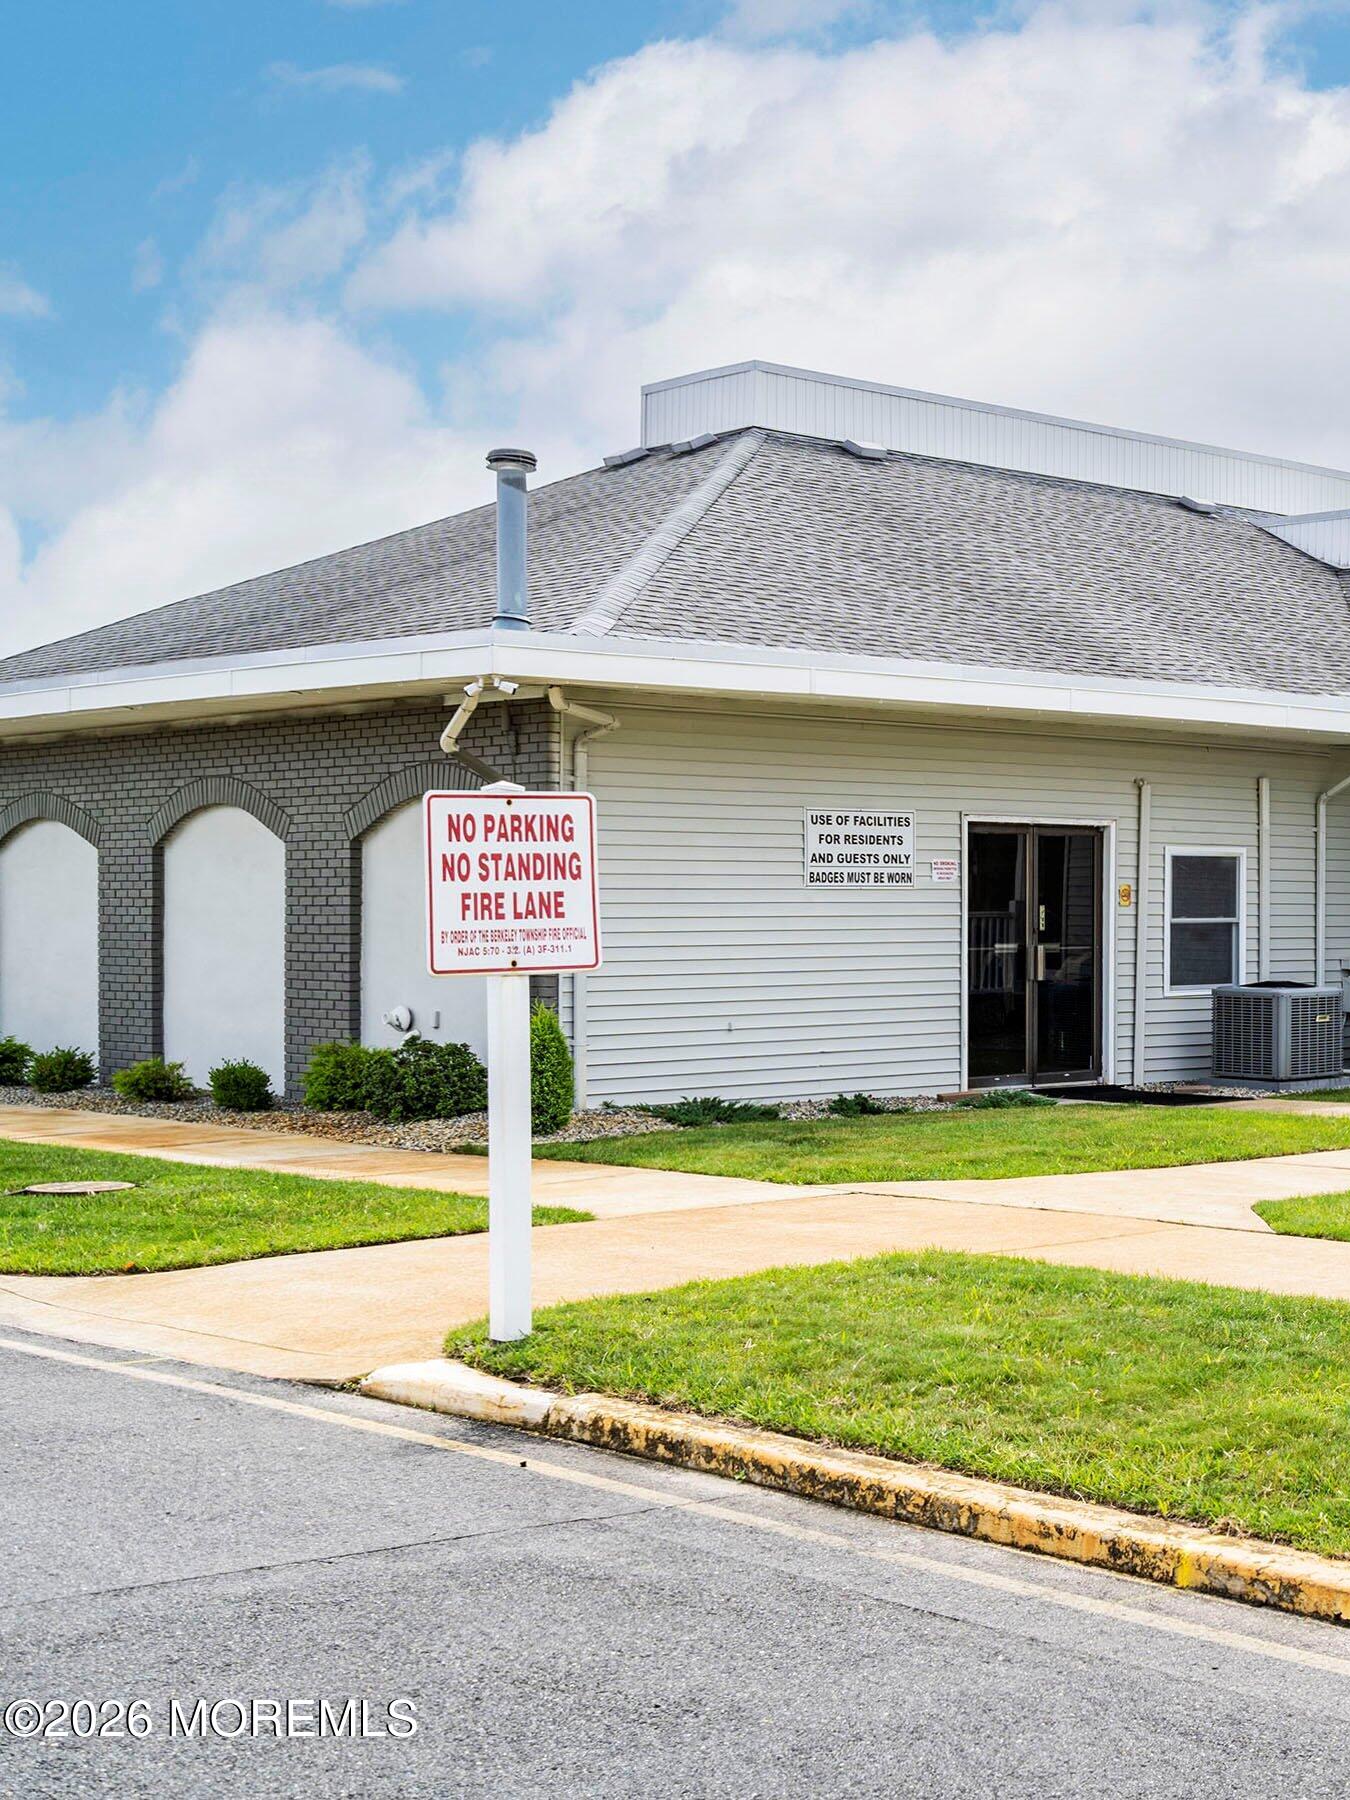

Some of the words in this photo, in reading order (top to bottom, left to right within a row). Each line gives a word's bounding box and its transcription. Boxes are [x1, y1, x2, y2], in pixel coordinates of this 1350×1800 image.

[447, 813, 477, 842] NO
[483, 813, 575, 842] PARKING
[810, 814, 833, 826] USE
[836, 815, 850, 826] OF
[853, 815, 911, 828] FACILITIES
[818, 834, 841, 845] FOR
[844, 834, 904, 846] RESIDENTS
[810, 853, 834, 864] AND
[837, 853, 880, 865] GUESTS
[883, 853, 911, 865] ONLY
[441, 852, 471, 882] NO
[478, 851, 582, 882] STANDING
[809, 871, 845, 884] BADGES
[846, 872, 872, 884] MUST
[874, 872, 885, 884] BE
[886, 872, 913, 884] WORN
[461, 892, 506, 921] FIRE
[513, 891, 566, 920] LANE
[441, 930, 450, 944] BY
[450, 930, 469, 943] ORDER
[470, 930, 478, 943] OF
[478, 930, 489, 943] THE
[490, 929, 518, 942] BERKELEY
[519, 928, 548, 941] TOWNSHIP
[549, 928, 561, 941] FIRE
[562, 927, 587, 940] OFFICIAL
[457, 946, 481, 956] NJAC
[483, 946, 500, 956] 5:70
[523, 945, 535, 956] (A)
